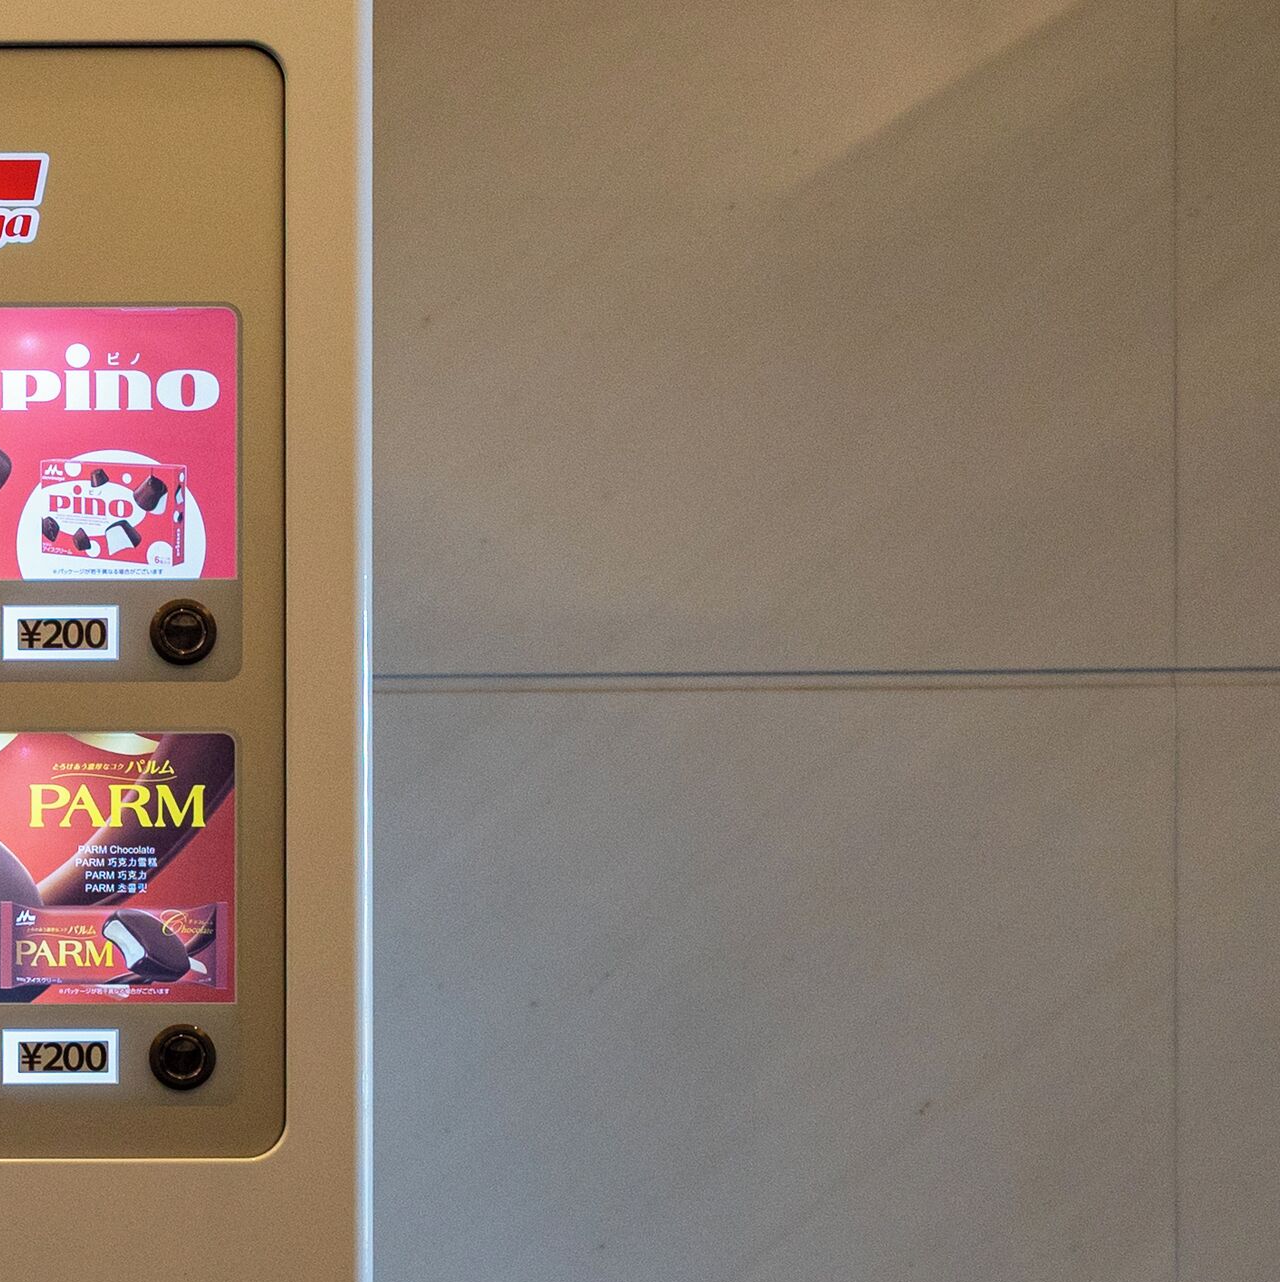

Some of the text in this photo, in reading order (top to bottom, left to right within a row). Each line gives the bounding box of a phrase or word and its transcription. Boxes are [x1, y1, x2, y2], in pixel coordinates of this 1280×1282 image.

[107, 352, 140, 365] ピノ
[1, 343, 220, 411] pino
[49, 485, 133, 517] pino
[21, 620, 106, 648] ¥200
[126, 760, 174, 775] パルム
[29, 784, 206, 827] PARM
[78, 846, 155, 854] PARM Chocolate
[76, 859, 104, 867] PARM
[85, 871, 114, 879] PARM
[85, 884, 114, 892] PARM
[15, 940, 114, 967] PARM
[22, 1042, 106, 1071] ¥200
